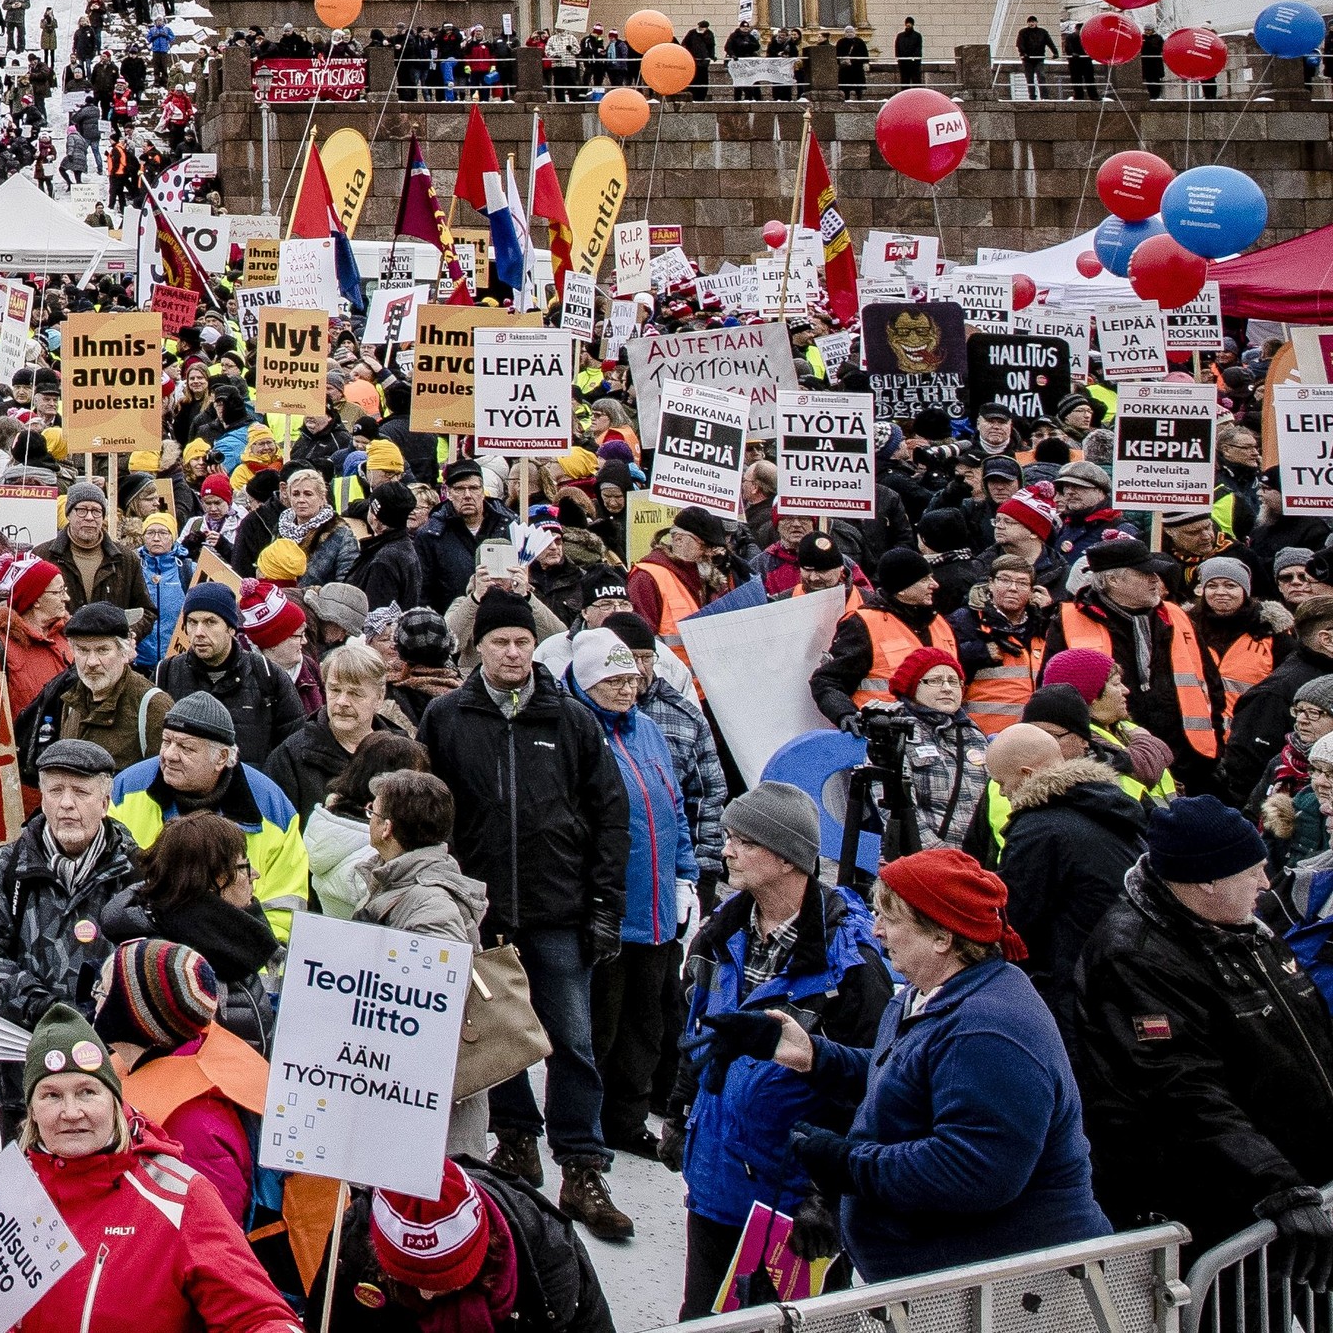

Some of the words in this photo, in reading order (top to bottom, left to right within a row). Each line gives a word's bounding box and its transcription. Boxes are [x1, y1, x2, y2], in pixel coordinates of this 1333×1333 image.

[935, 119, 964, 135] PAM
[620, 227, 643, 246] R.I.P.
[963, 297, 1002, 309] MALLI
[1036, 323, 1085, 336] LEIPÄÄ
[1102, 315, 1155, 333] LEIPÄÄ
[264, 322, 322, 356] Nyt
[1122, 334, 1140, 346] JA
[1168, 329, 1218, 339] ROSKIIN
[72, 334, 156, 357] Ihmis-
[647, 331, 763, 364] AUTETAAN
[1107, 347, 1158, 362] TYÖTÄ
[989, 344, 1058, 367] HALLITUS
[263, 356, 320, 374] loppuu
[483, 354, 563, 377] LEIPÄÄ
[72, 369, 155, 387] arvon
[262, 375, 319, 389] kyykytys!
[1007, 371, 1030, 391] ON
[509, 383, 536, 402] JA
[72, 395, 155, 413] puolesta!
[667, 400, 742, 426] PORKKANAA
[1123, 404, 1209, 415] PORKKANAA
[485, 405, 561, 428] TYÖTÄ
[784, 410, 866, 435] TYÖTÄ
[694, 421, 711, 439] EI
[1155, 420, 1175, 437] EI
[102, 437, 136, 446] Talentia
[483, 439, 562, 448] #ÄÄNITYÖTTÖMÄLLE
[815, 437, 834, 452] JA
[1125, 438, 1204, 459] KEPPIÄ
[664, 437, 735, 466] KEPPIÄ
[673, 461, 721, 480] Palveluita
[781, 454, 870, 474] TURVAA
[1136, 465, 1190, 476] Palveluita
[655, 472, 705, 494] pelottelun
[790, 475, 802, 489] Ei
[805, 475, 862, 491] raippaa!
[1118, 477, 1174, 490] pelottelun
[1176, 479, 1207, 490] sijaan
[656, 486, 731, 510] #ÄÄNITYÖTTÖMÄLLE
[786, 498, 865, 510] #ÄÄNITYÖTTÖMÄLLE
[1121, 493, 1204, 505] #ÄÄNITYÖTTÖMÄLLE
[594, 585, 628, 600] LAPPI
[303, 959, 448, 1013] Teollisuus
[351, 997, 420, 1038] liitto
[336, 1041, 391, 1072] ÄÄNI
[282, 1062, 440, 1111] TYÖTTÖMÄLLE
[104, 1226, 135, 1236] HALTI
[406, 1234, 435, 1247] PAM
